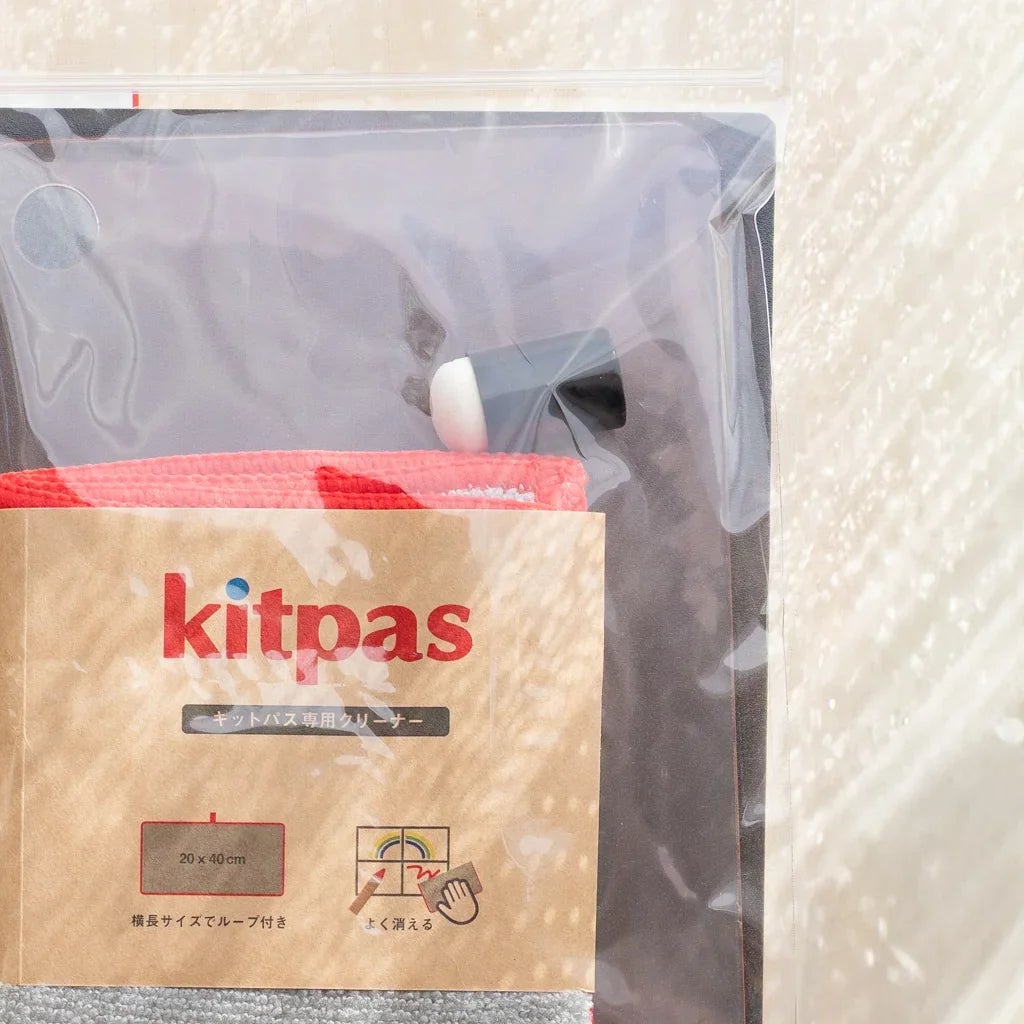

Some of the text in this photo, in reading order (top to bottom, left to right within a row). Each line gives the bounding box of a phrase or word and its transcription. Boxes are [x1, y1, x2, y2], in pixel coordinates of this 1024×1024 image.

[163, 572, 473, 686] kitpas
[212, 710, 425, 730] キットパス専用クリーナー
[179, 852, 195, 865] 20
[209, 853, 225, 865] 40
[226, 856, 246, 865] cm
[131, 913, 287, 929] 横長サイズでループ付き
[364, 917, 434, 931] よく消える
